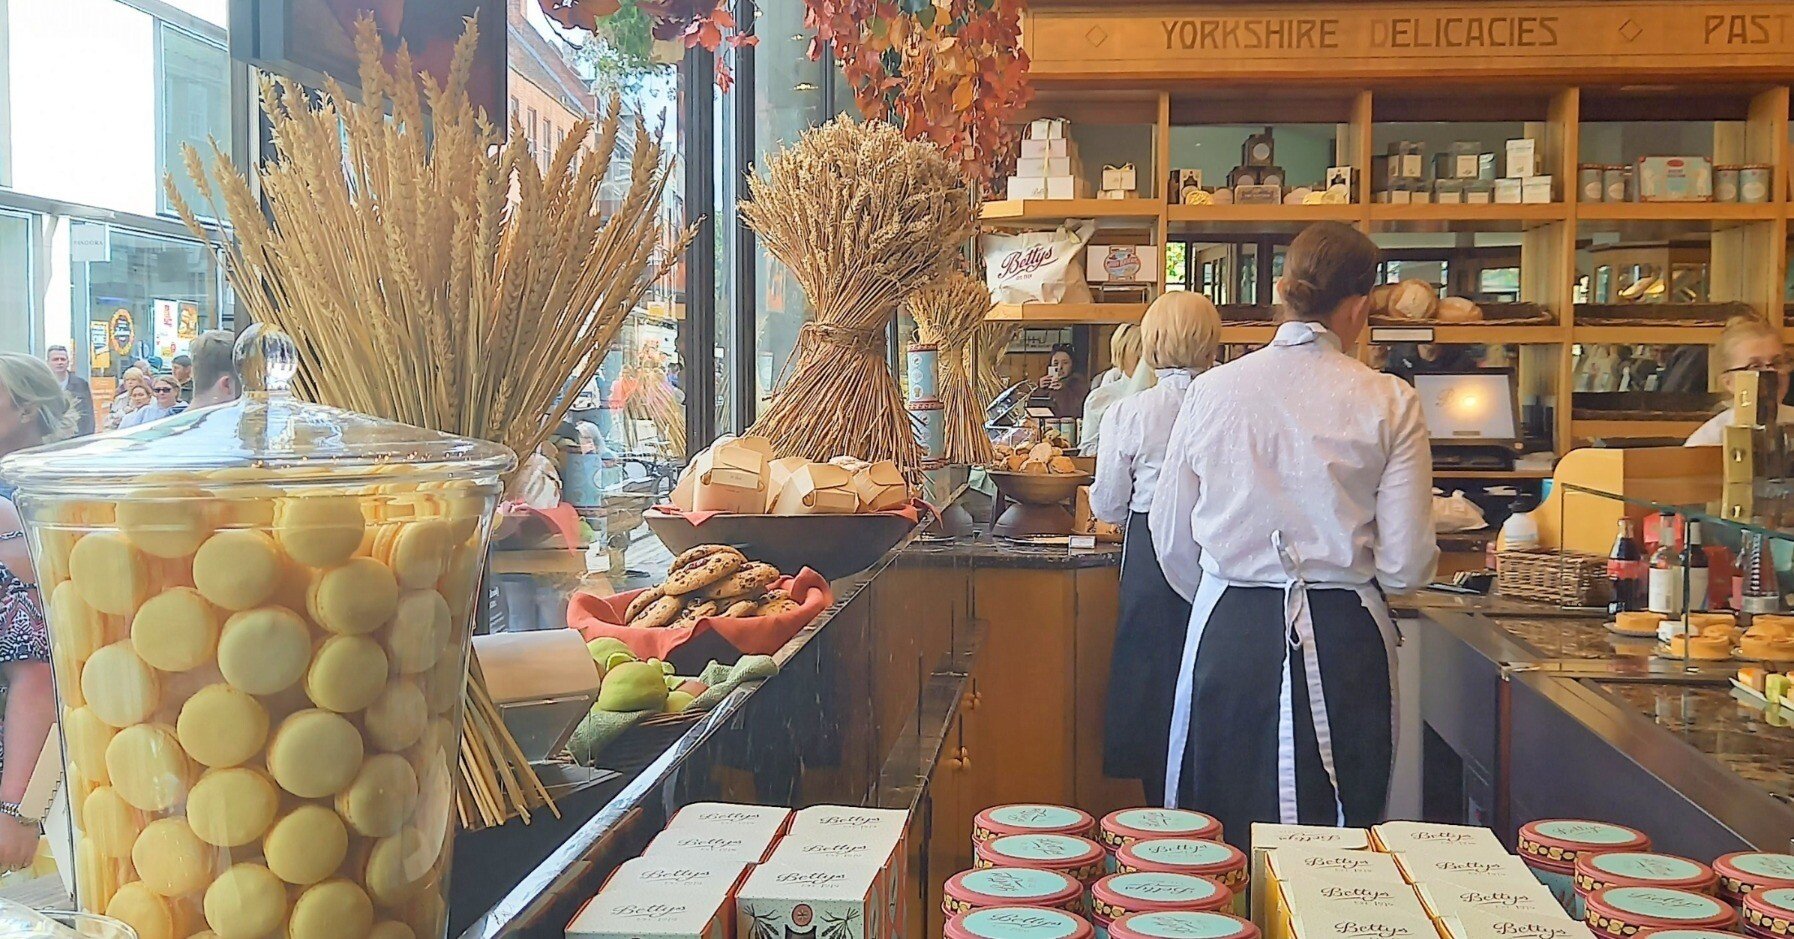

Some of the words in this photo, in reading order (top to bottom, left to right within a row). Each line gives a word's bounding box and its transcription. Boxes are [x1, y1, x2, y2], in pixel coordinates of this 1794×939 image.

[1161, 19, 1340, 50] YORKSHIRE
[1369, 16, 1559, 48] DELICACIES
[1704, 14, 1793, 45] PAST
[998, 244, 1058, 281] Bettys
[1410, 831, 1474, 842] Bettys
[1303, 857, 1371, 869] Bettys
[1436, 861, 1503, 873] Bettys
[639, 869, 710, 882] Bettys
[775, 872, 845, 885] Bettys
[1321, 886, 1394, 902] Bettys
[1460, 891, 1533, 905] Bettys
[611, 904, 687, 918] Bettys
[990, 914, 1062, 928] Bettys
[1334, 921, 1414, 938] Bettys
[1493, 921, 1572, 939] Bettys
